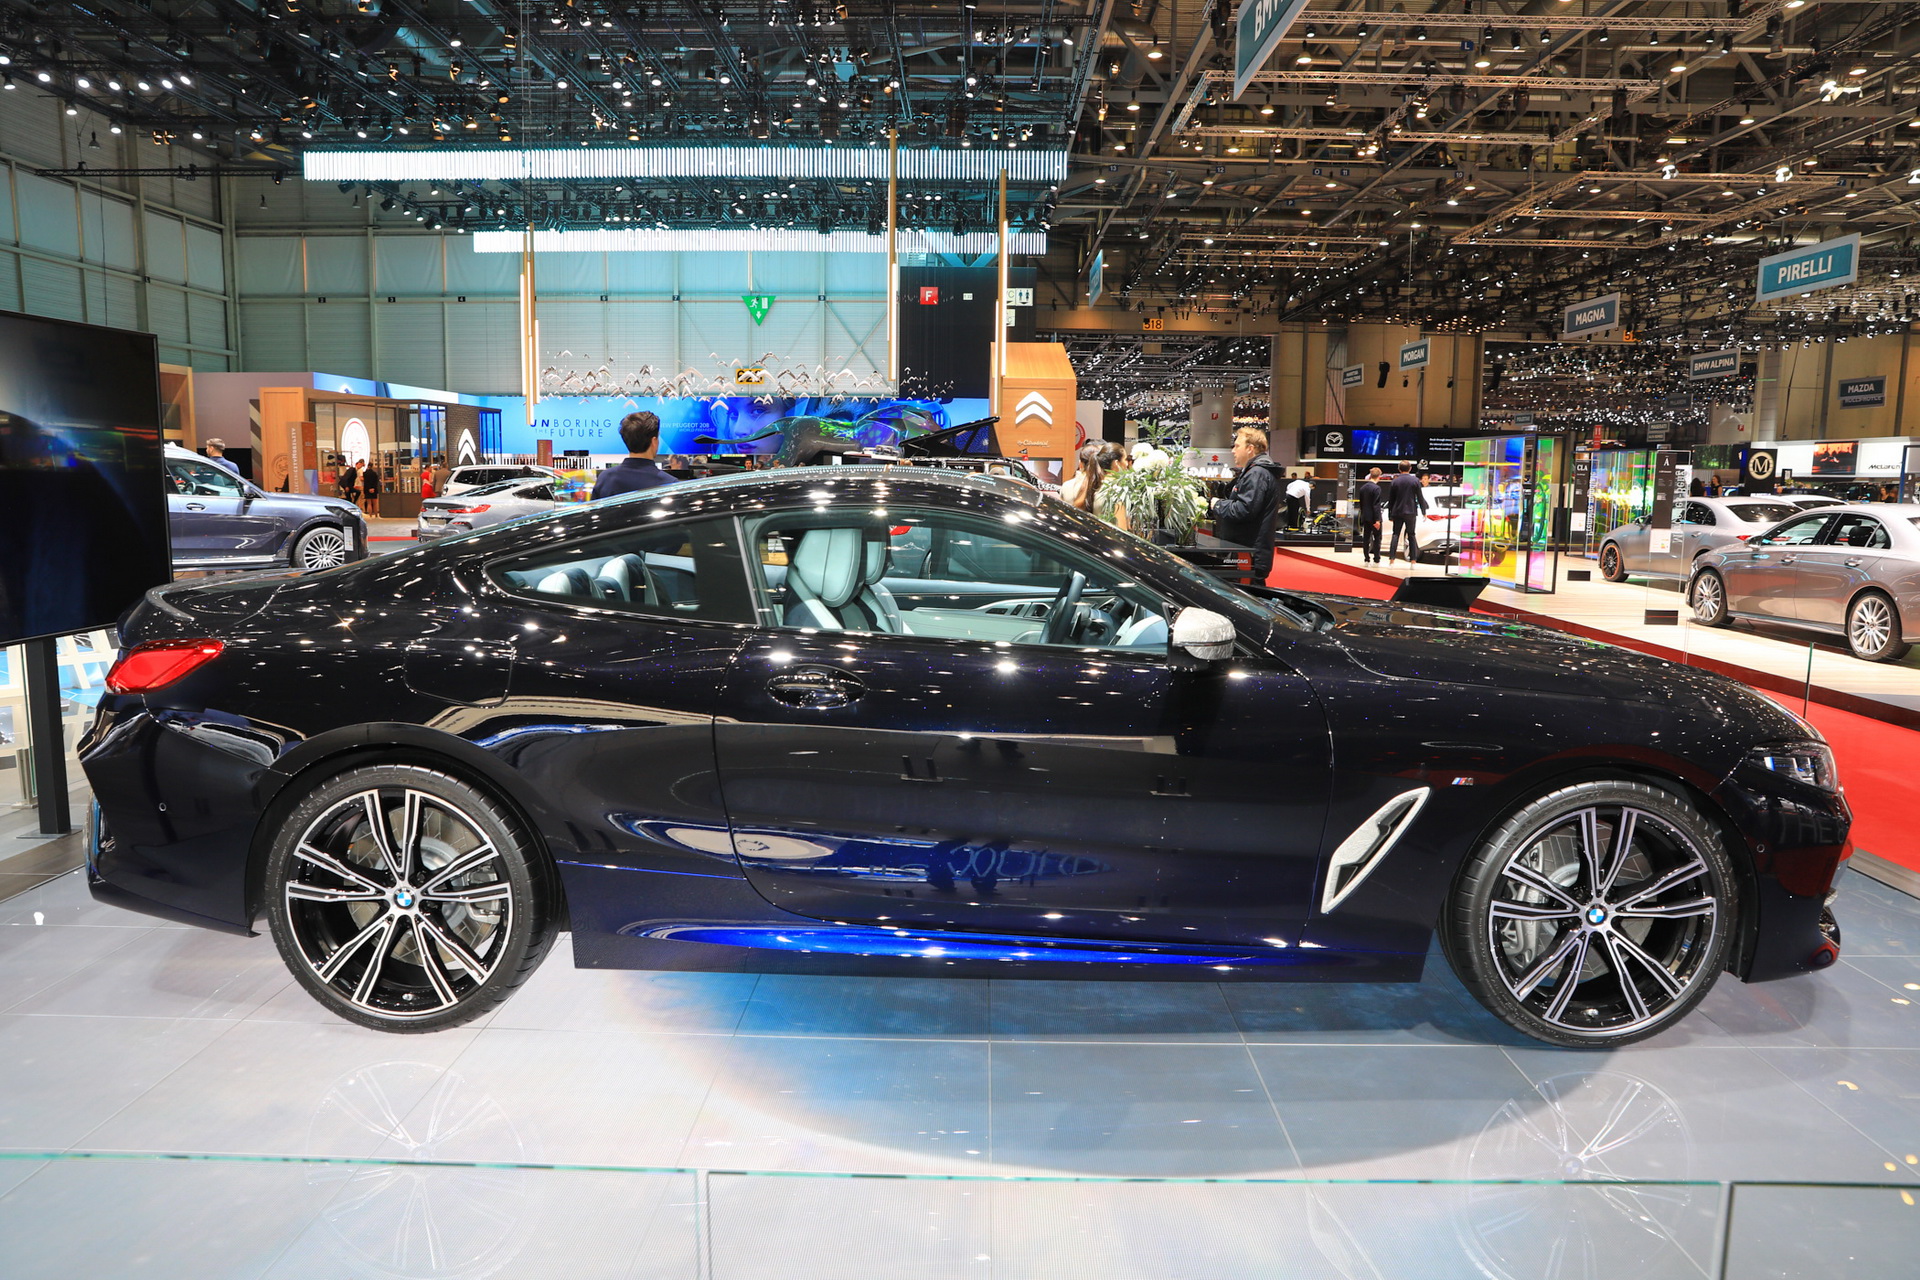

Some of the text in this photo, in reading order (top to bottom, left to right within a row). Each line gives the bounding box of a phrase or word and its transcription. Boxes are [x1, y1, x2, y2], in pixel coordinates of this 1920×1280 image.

[1464, 41, 1470, 50] L
[1777, 254, 1834, 284] PIRELLI
[925, 290, 933, 302] F
[1575, 307, 1606, 326] MAGNA
[1403, 347, 1425, 363] MORGAN
[1694, 357, 1735, 371] BMW ALPINA
[1847, 383, 1875, 394] MAZDA
[550, 428, 604, 438] FUTURE
